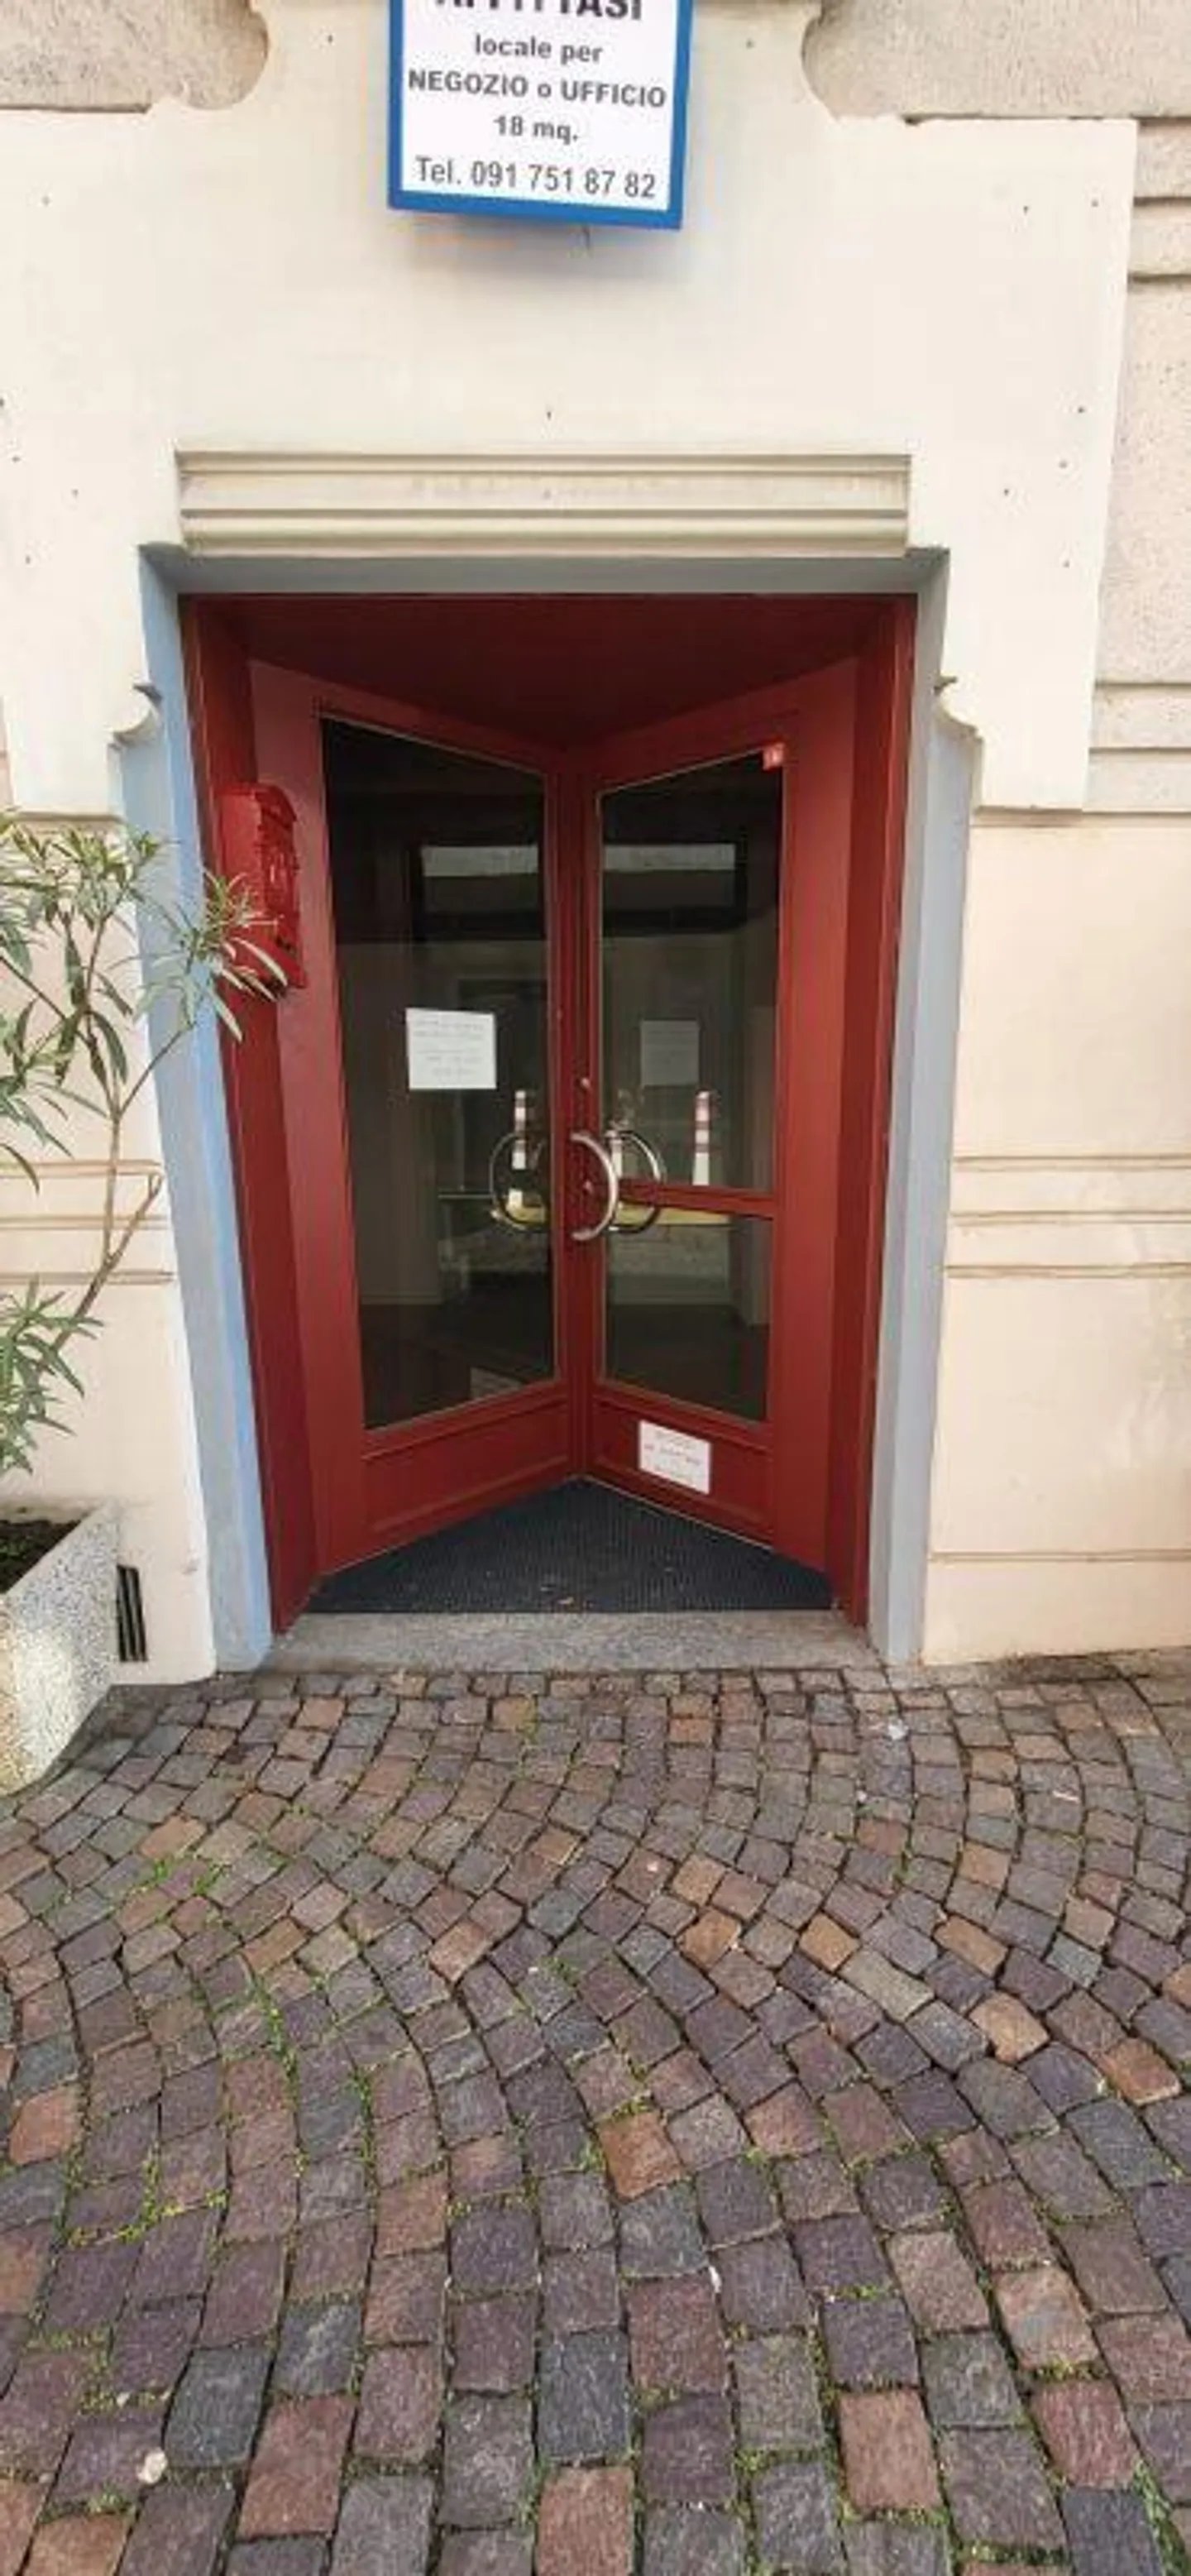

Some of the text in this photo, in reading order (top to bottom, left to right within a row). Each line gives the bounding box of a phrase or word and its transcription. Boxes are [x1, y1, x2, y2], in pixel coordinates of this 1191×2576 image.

[475, 34, 603, 65] locale per
[408, 69, 667, 108] NEGOZIO o UFFICIO
[494, 116, 578, 145] 18 mq.
[416, 157, 655, 199] Tel. 091 751 87 82
